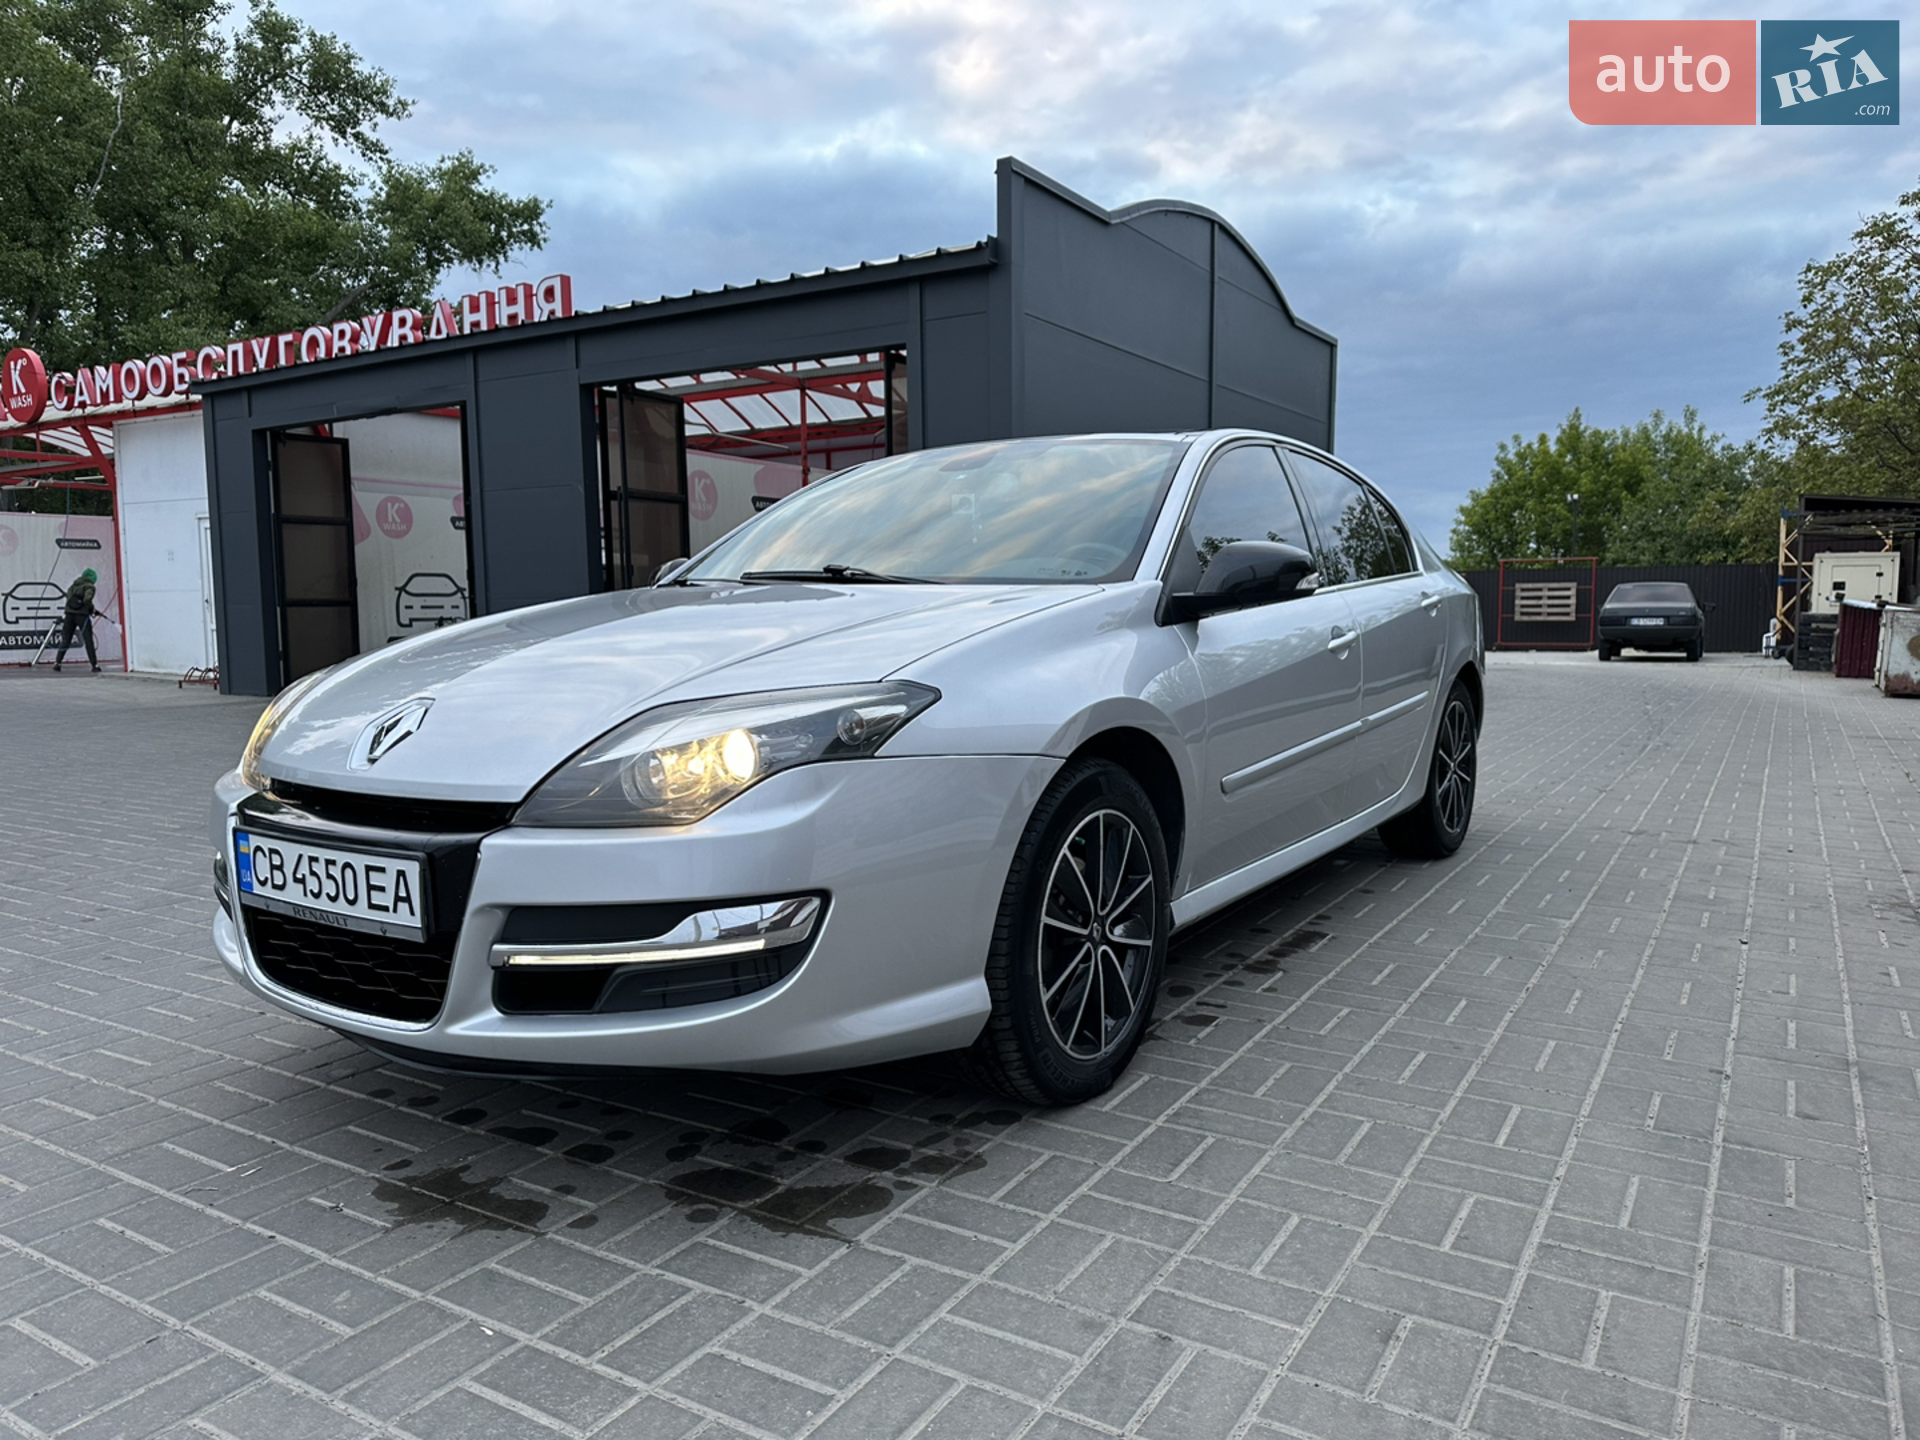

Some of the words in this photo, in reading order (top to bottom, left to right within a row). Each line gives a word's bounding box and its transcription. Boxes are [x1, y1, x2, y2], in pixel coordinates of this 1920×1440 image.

[50, 273, 573, 411] САМООБСЛУГОВУВАННЯ
[9, 393, 33, 409] WASH
[383, 522, 407, 531] WASH
[252, 844, 287, 891] CB
[292, 853, 358, 906] 4550
[364, 863, 416, 917] EA
[292, 906, 349, 927] RENAULT
